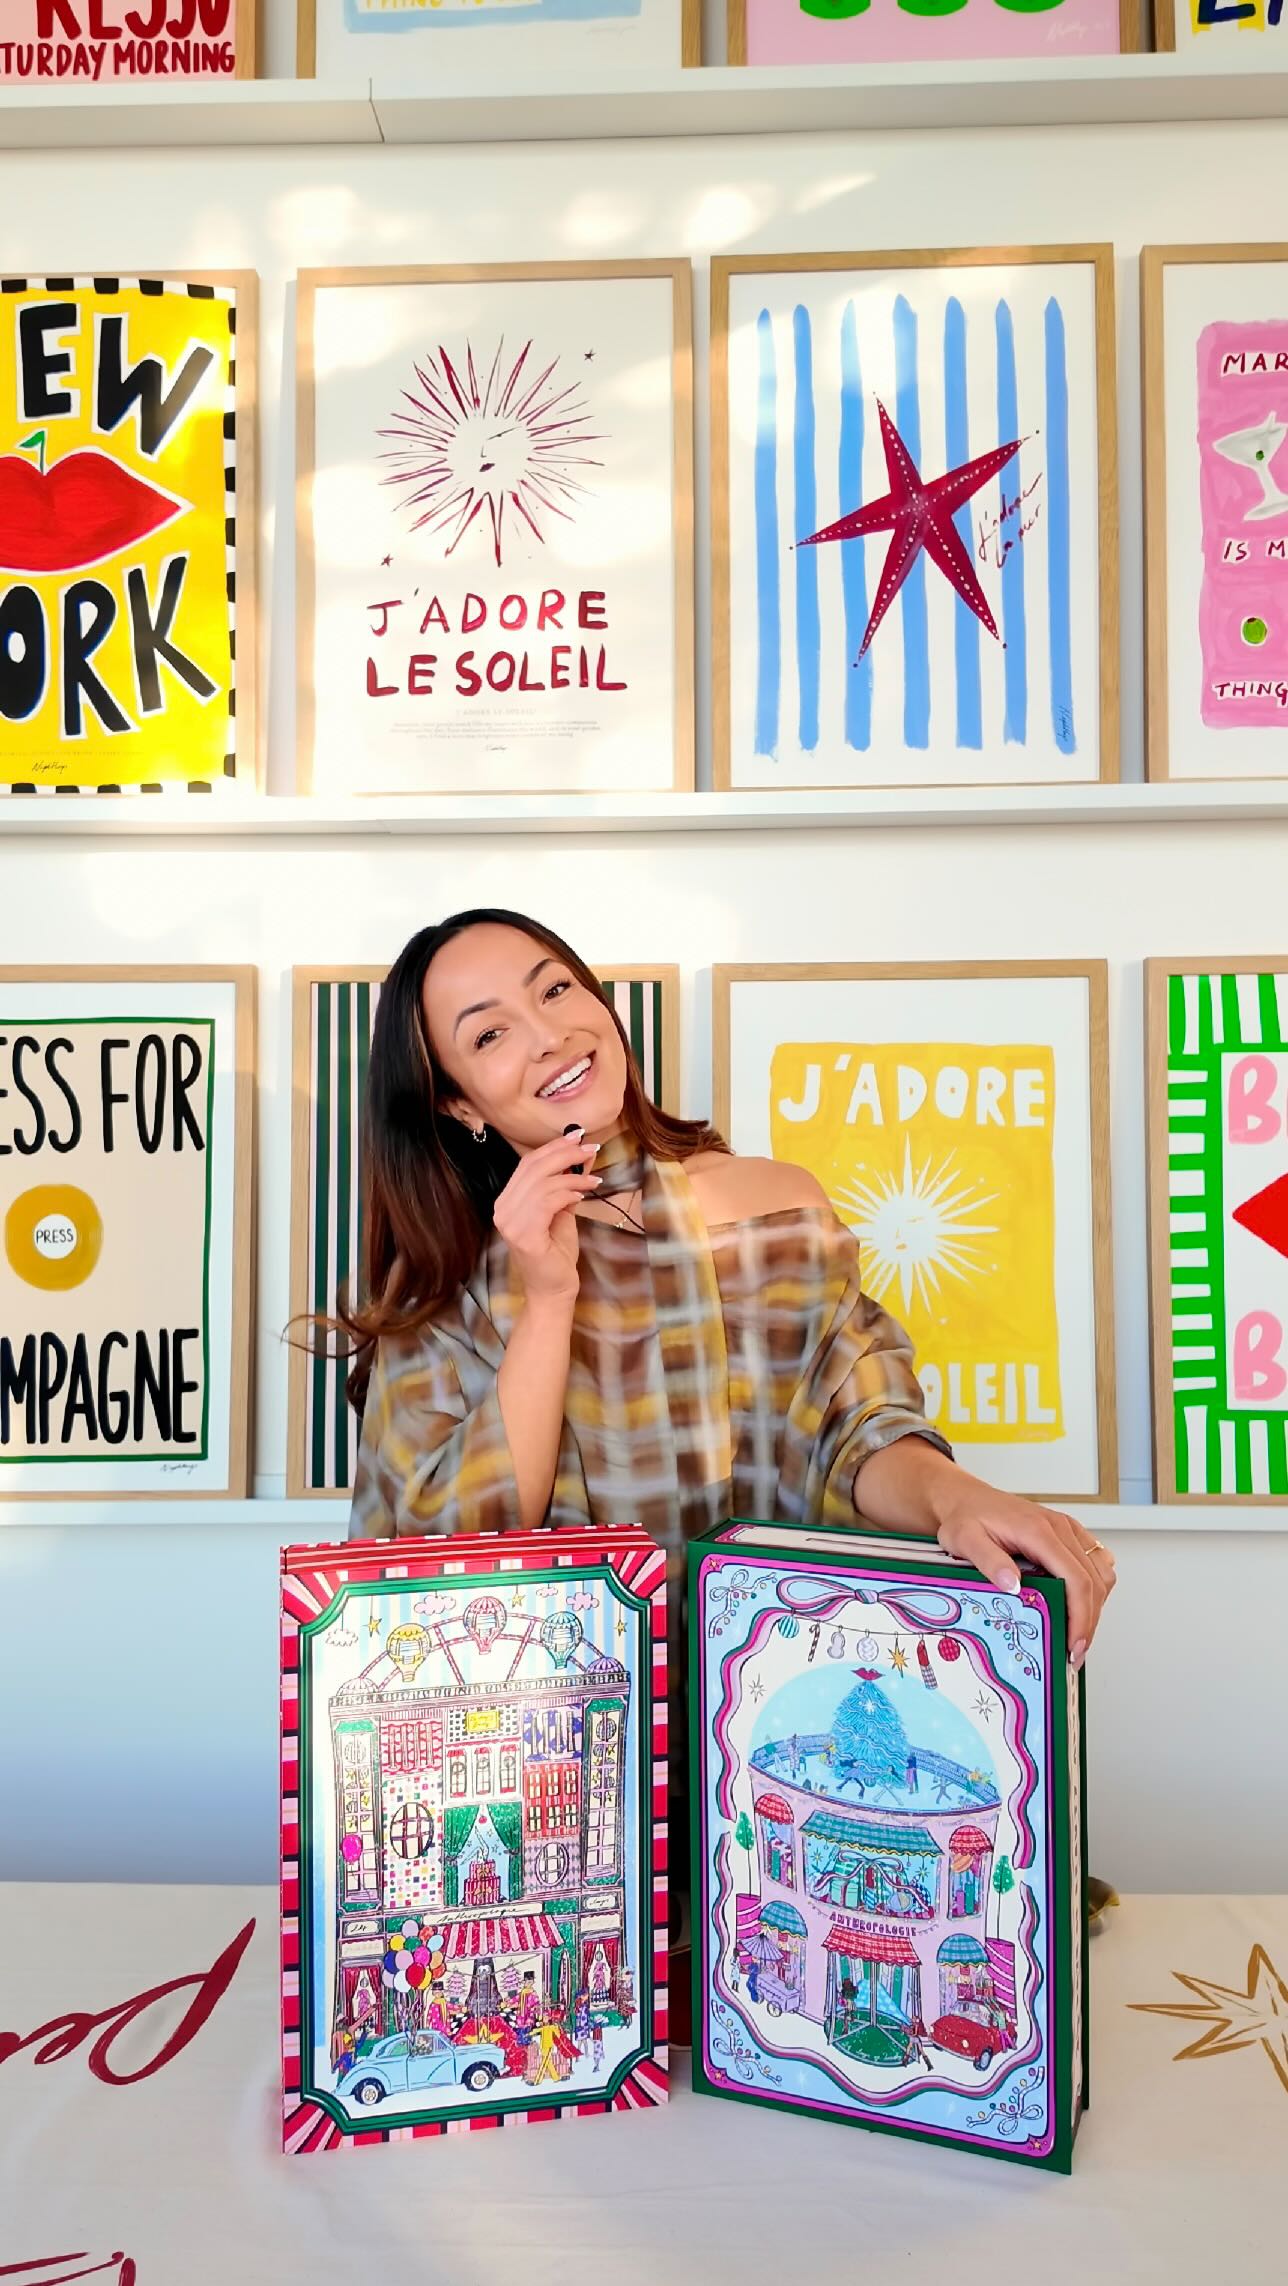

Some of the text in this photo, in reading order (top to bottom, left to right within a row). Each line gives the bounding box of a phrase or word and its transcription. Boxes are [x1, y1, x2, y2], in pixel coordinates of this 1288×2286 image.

[0, 40, 236, 81] TURDAY MORNING
[20, 302, 215, 456] EW
[1223, 352, 1288, 374] MAR
[1223, 540, 1248, 561] IS
[366, 587, 609, 636] J'ADORE
[0, 556, 218, 736] ORK
[366, 644, 628, 697] LE SOLEIL
[1215, 682, 1288, 706] THING
[101, 1034, 205, 1153] FOR
[778, 1054, 1046, 1127] J'ADORE
[1228, 1054, 1288, 1144] B
[36, 1228, 74, 1244] PRESS
[0, 1328, 200, 1445] MPAGNE
[829, 1911, 917, 1937] ANTHROPOLOGIE
